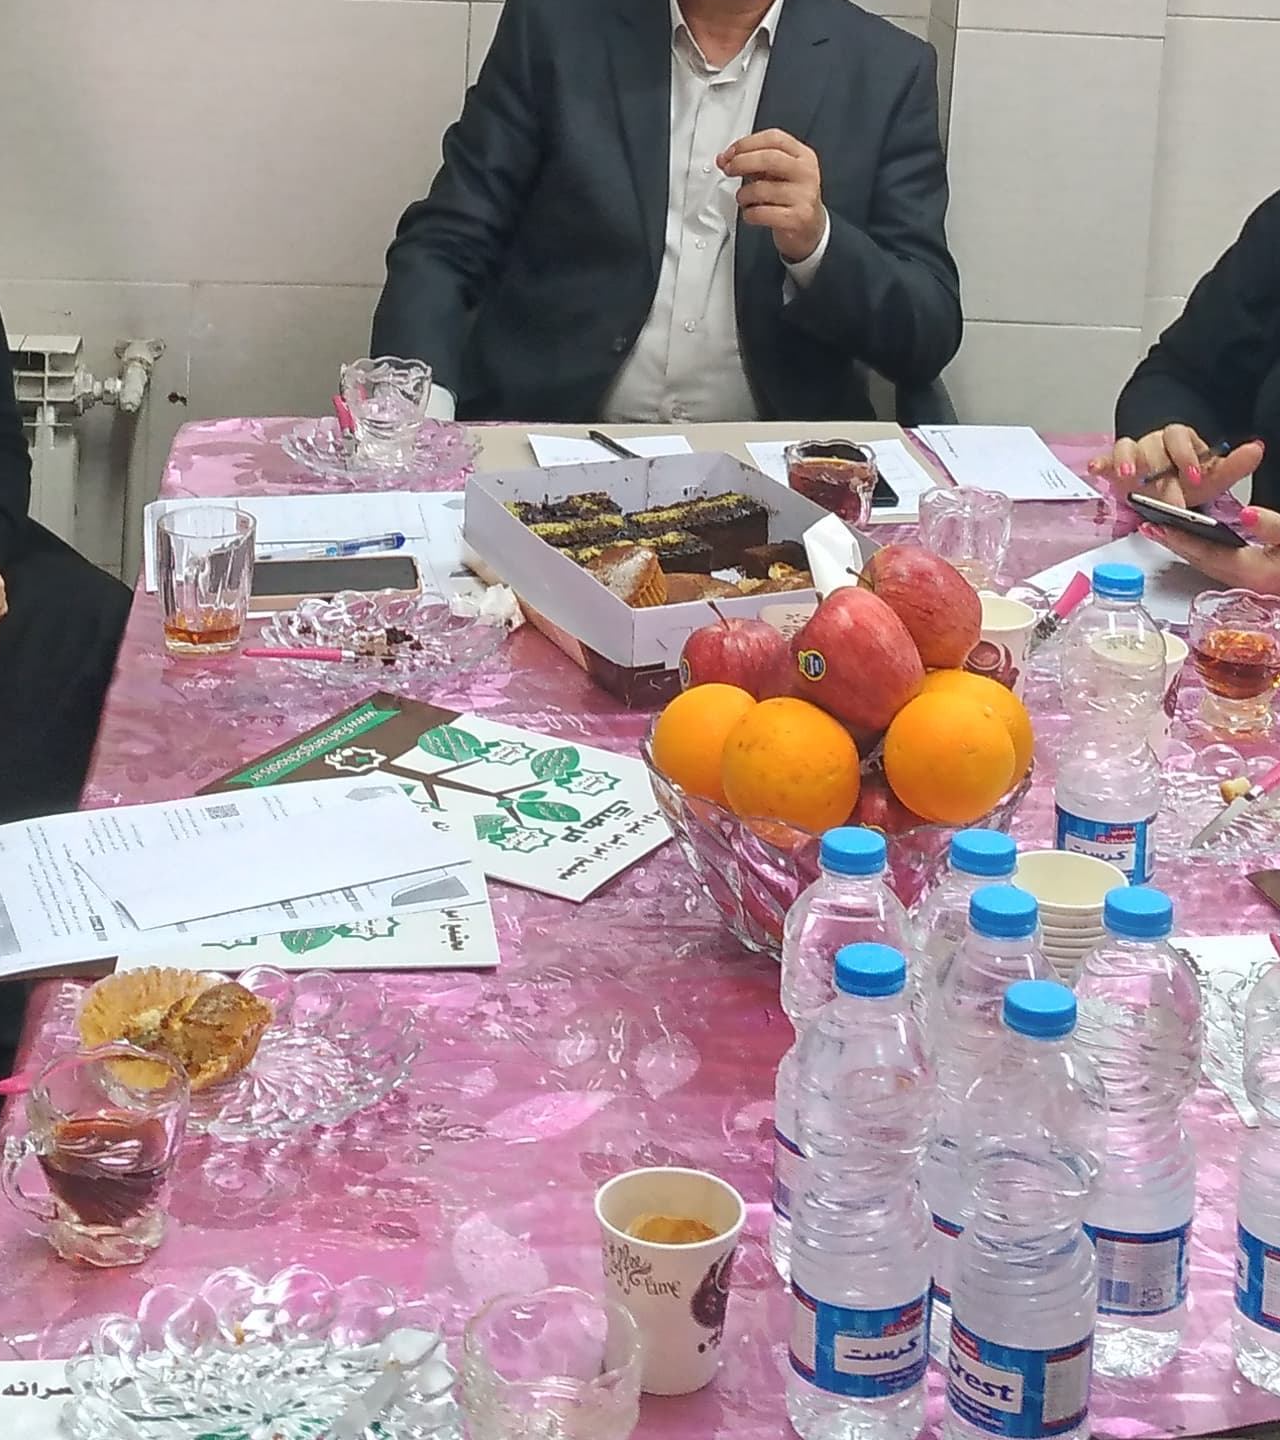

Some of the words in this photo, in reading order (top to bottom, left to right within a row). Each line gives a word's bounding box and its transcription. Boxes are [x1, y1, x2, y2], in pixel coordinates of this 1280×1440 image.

[560, 799, 635, 844] فرهنگ
[1070, 843, 1129, 861] کرست
[557, 856, 594, 881] مجتمع
[642, 1275, 682, 1300] time
[842, 1332, 920, 1363] کرست
